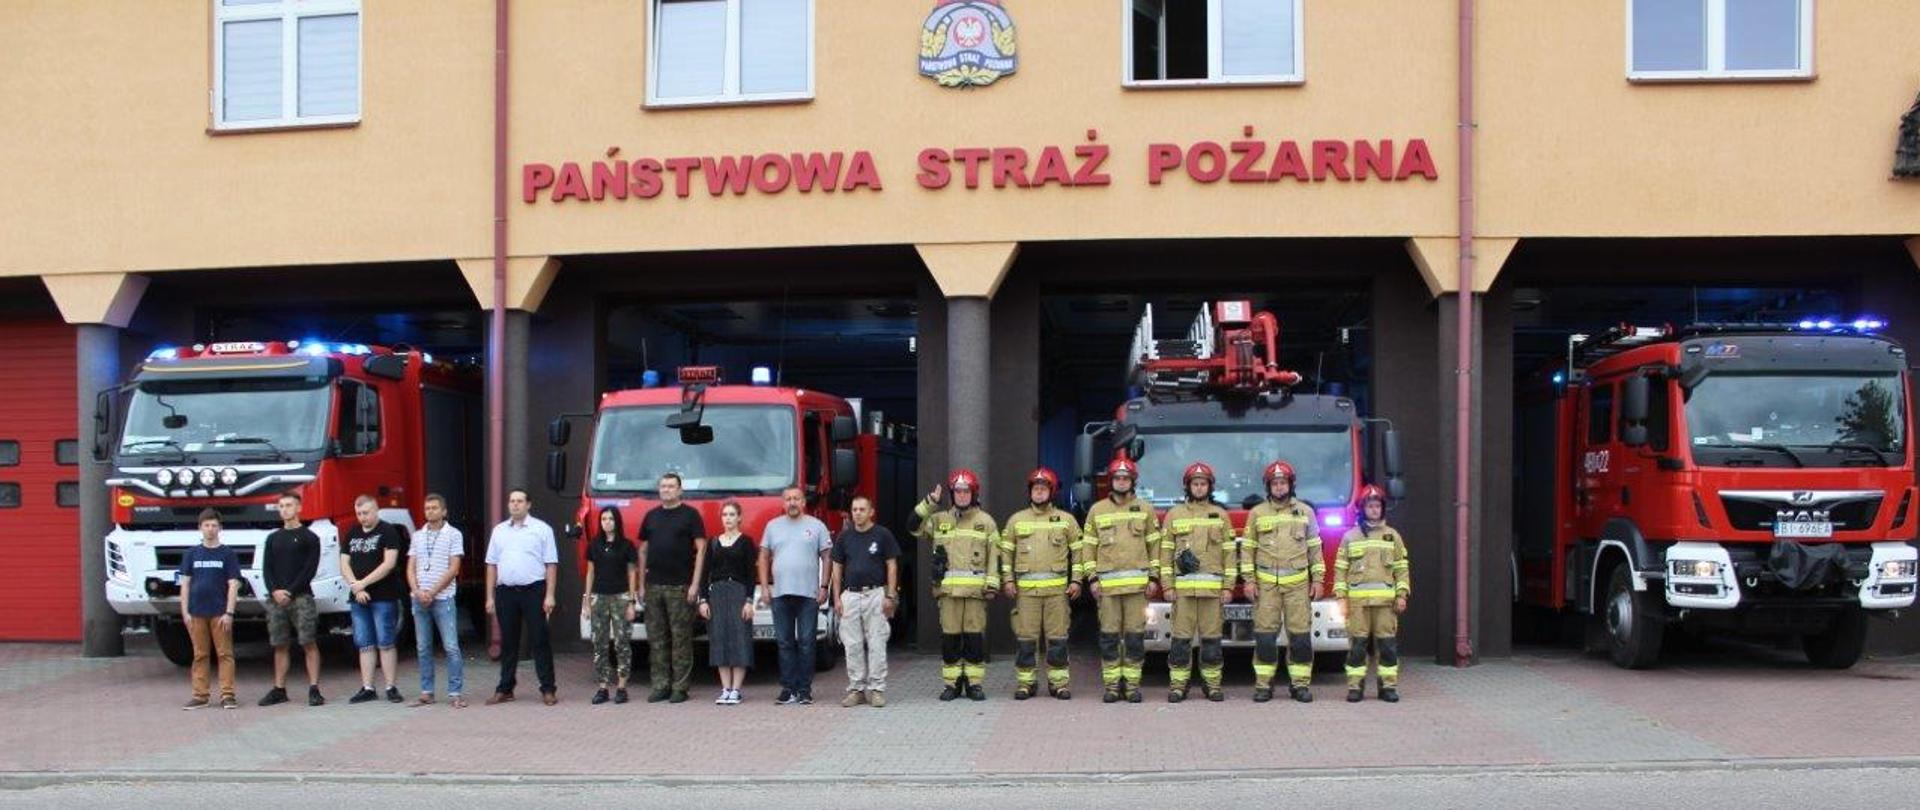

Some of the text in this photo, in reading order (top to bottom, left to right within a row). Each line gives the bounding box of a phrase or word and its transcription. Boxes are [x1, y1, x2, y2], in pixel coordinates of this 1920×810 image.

[523, 126, 1438, 203] PAŃSTWOWA STRAŻ POŻARNA
[1776, 510, 1830, 522] MAN
